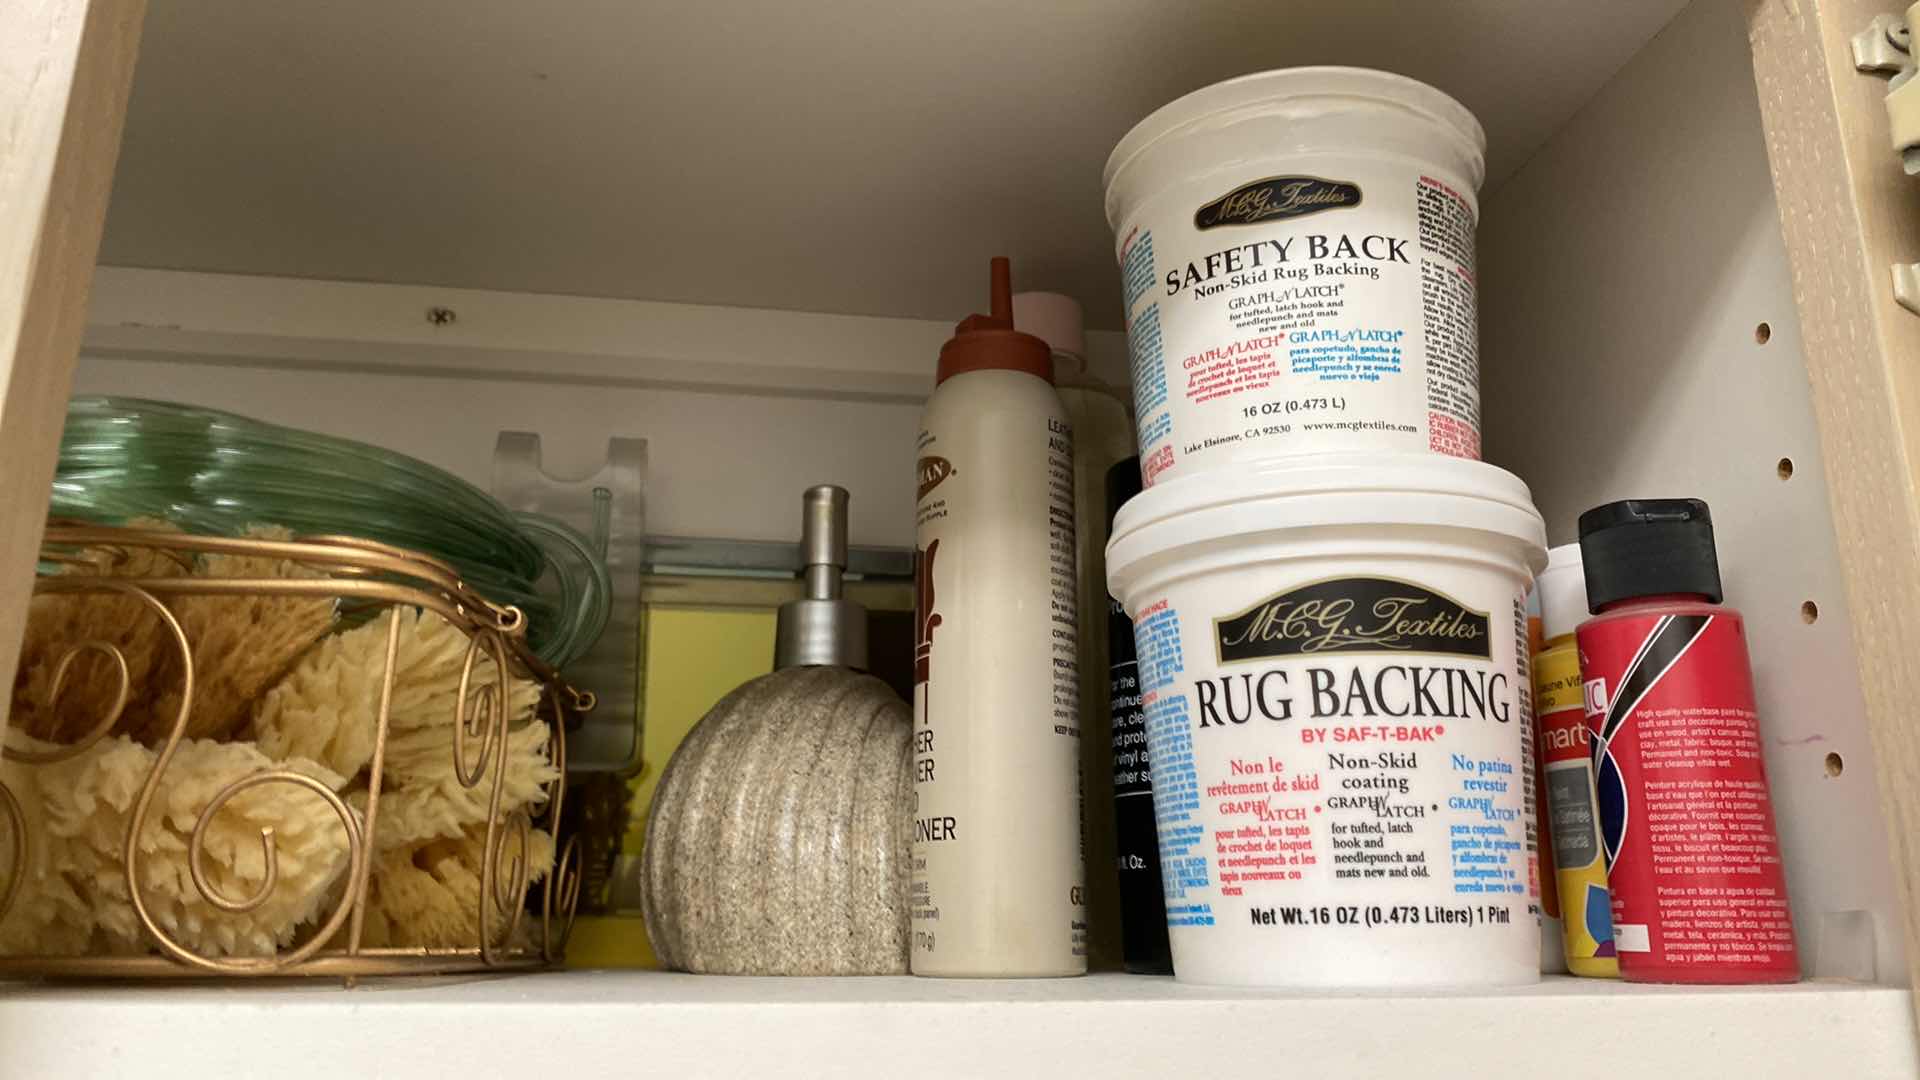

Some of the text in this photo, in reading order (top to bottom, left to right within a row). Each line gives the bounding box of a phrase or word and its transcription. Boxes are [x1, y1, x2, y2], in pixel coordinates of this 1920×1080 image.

[1274, 182, 1346, 208] Textiles
[1166, 236, 1294, 296] SAFETY
[1305, 234, 1411, 265] BACK
[1194, 263, 1380, 300] Non-Skid Rug Backing
[1229, 299, 1344, 321] for tufted, latch hook and
[1236, 309, 1338, 328] needlepunch and mats
[1258, 319, 1316, 333] new and old
[1242, 397, 1346, 418] 16 OZ (0.473 L)
[1303, 419, 1417, 434] www.mcgtextiles.com
[1184, 423, 1291, 455] Lake Elsinore, CA 92530
[1223, 599, 1354, 652] M.C.G.
[1356, 597, 1484, 641] Textiles
[1120, 677, 1136, 689] the
[1194, 665, 1510, 728] RUG BACKING
[1671, 718, 1687, 726] and
[1302, 728, 1326, 744] BY
[1119, 751, 1138, 768] vinyl
[1230, 756, 1284, 776] Non le
[1328, 752, 1418, 769] Non-Skid
[1452, 754, 1513, 776] No patina
[1272, 775, 1287, 792] de
[1292, 773, 1320, 791] skid
[1342, 772, 1409, 793] coating
[1463, 776, 1508, 792] revestir
[1268, 825, 1282, 836] les
[1285, 825, 1311, 839] tapis
[1331, 822, 1413, 836] for tufted, latch
[1228, 840, 1262, 852] crochet
[1265, 839, 1277, 851] de
[1280, 839, 1312, 853] loquet
[1332, 837, 1384, 848] hook and
[1129, 854, 1147, 870] Oz.
[1301, 852, 1317, 864] les
[1334, 850, 1425, 866] needlepunch and
[1336, 865, 1430, 878] mats new and old.
[1250, 907, 1276, 925] Net
[1336, 906, 1360, 925] OZ
[1365, 905, 1420, 928] (0.473
[1425, 905, 1474, 928] Liters)
[1477, 907, 1484, 924] 1
[1488, 906, 1511, 924] Pint
